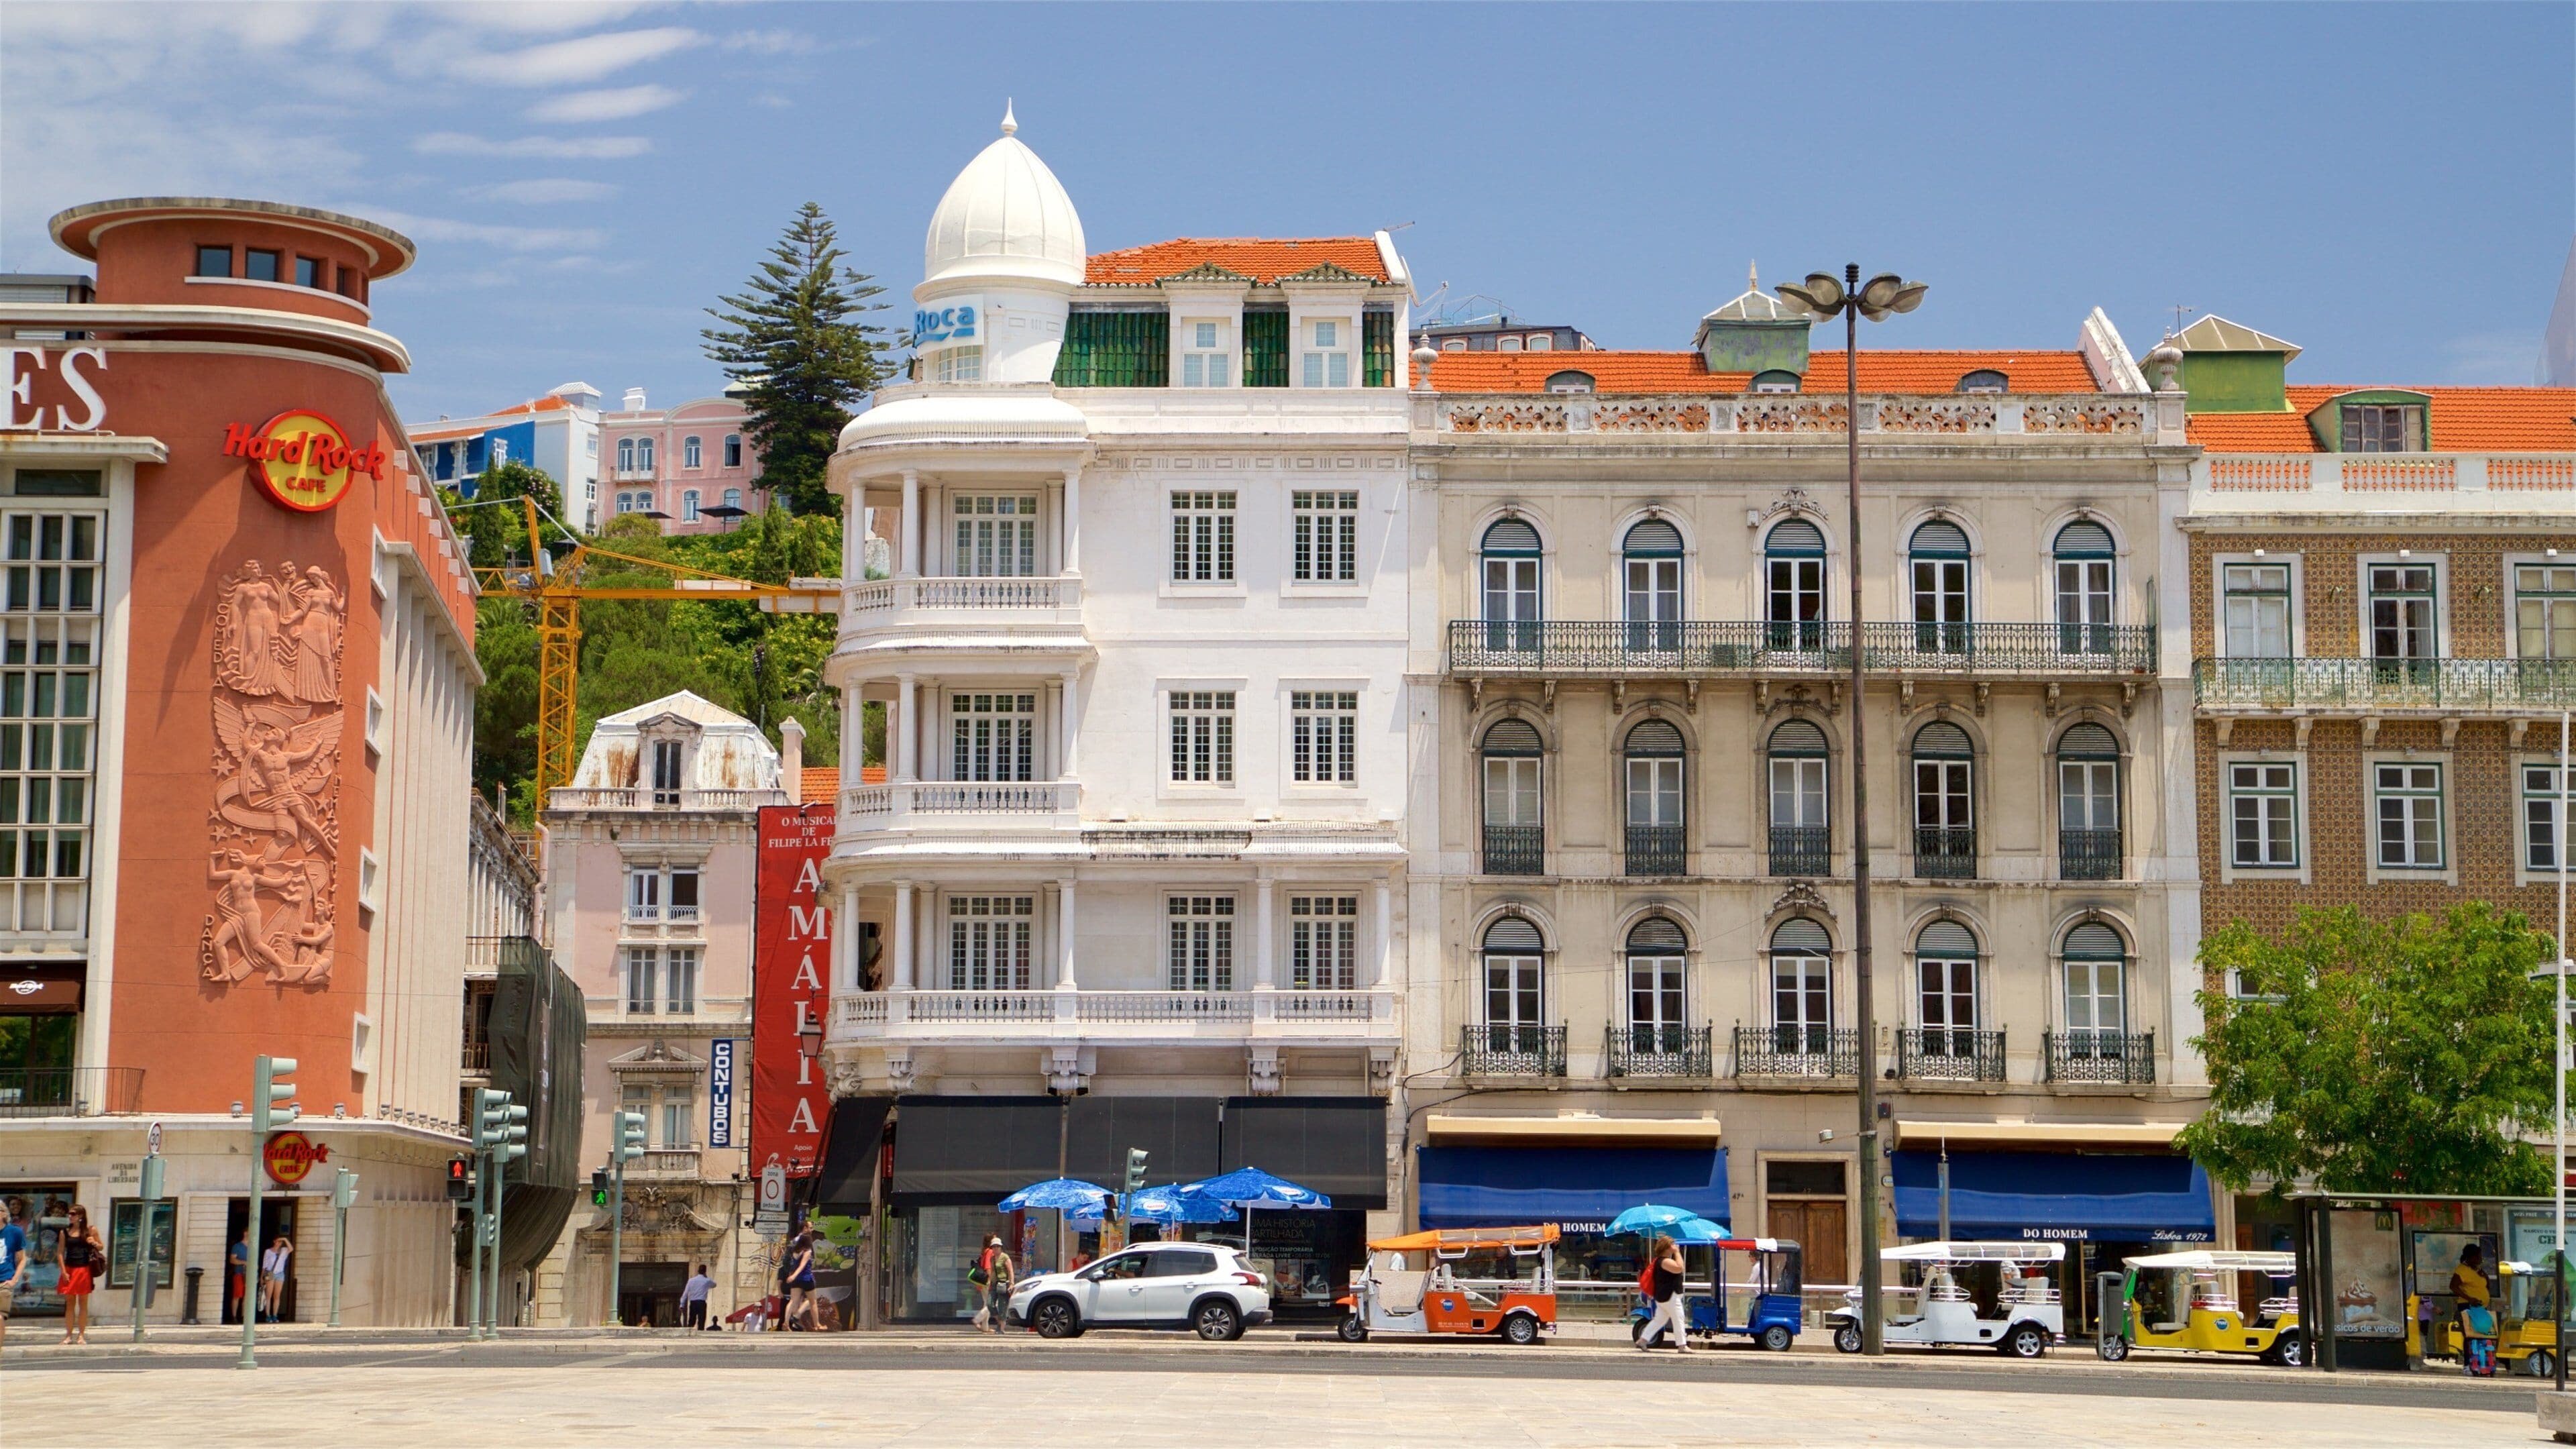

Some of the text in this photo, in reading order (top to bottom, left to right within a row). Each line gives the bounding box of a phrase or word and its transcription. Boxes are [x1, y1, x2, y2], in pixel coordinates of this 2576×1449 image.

[914, 307, 975, 334] Roca
[0, 346, 107, 431] ES
[223, 422, 386, 481] Hard Rock
[286, 476, 326, 493] CAFE
[782, 817, 790, 826] O
[802, 827, 816, 837] DE
[768, 838, 802, 848] FILIPE
[805, 837, 818, 847] LA
[202, 914, 214, 978] DANÇA
[712, 1043, 731, 1144] CONTUBOS
[150, 1133, 159, 1146] 30
[295, 1143, 329, 1163] Rock
[279, 1165, 301, 1173] CAFE
[1562, 1223, 1606, 1232] HOMEM
[2023, 1229, 2088, 1238] DO HOMEM
[2151, 1230, 2208, 1241] Lisboa 1972
[2360, 1324, 2372, 1332] de
[2374, 1324, 2400, 1333] verão
